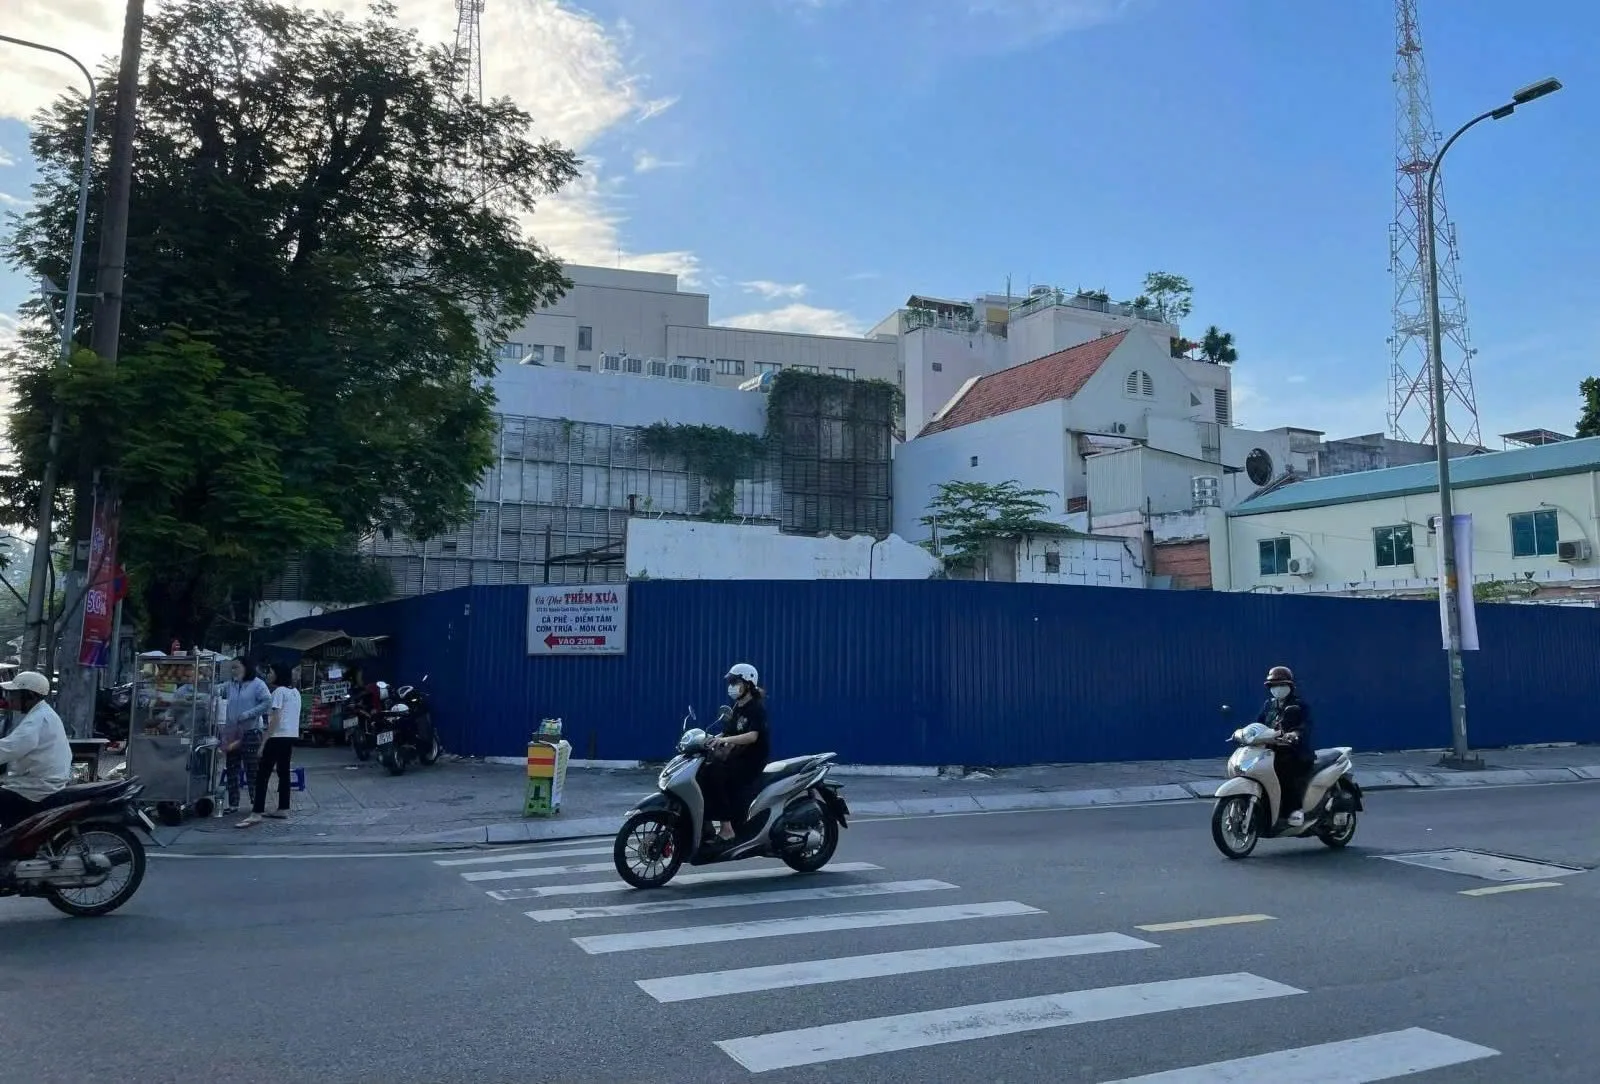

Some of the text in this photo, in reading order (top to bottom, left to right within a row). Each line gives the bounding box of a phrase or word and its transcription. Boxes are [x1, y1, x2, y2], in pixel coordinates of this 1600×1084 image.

[595, 590, 618, 604] XƯA
[553, 615, 568, 624] PHÊ
[595, 615, 612, 623] TÂM
[536, 625, 552, 633] CƠM
[554, 624, 573, 632] TRƯA
[598, 624, 618, 632] CHAY
